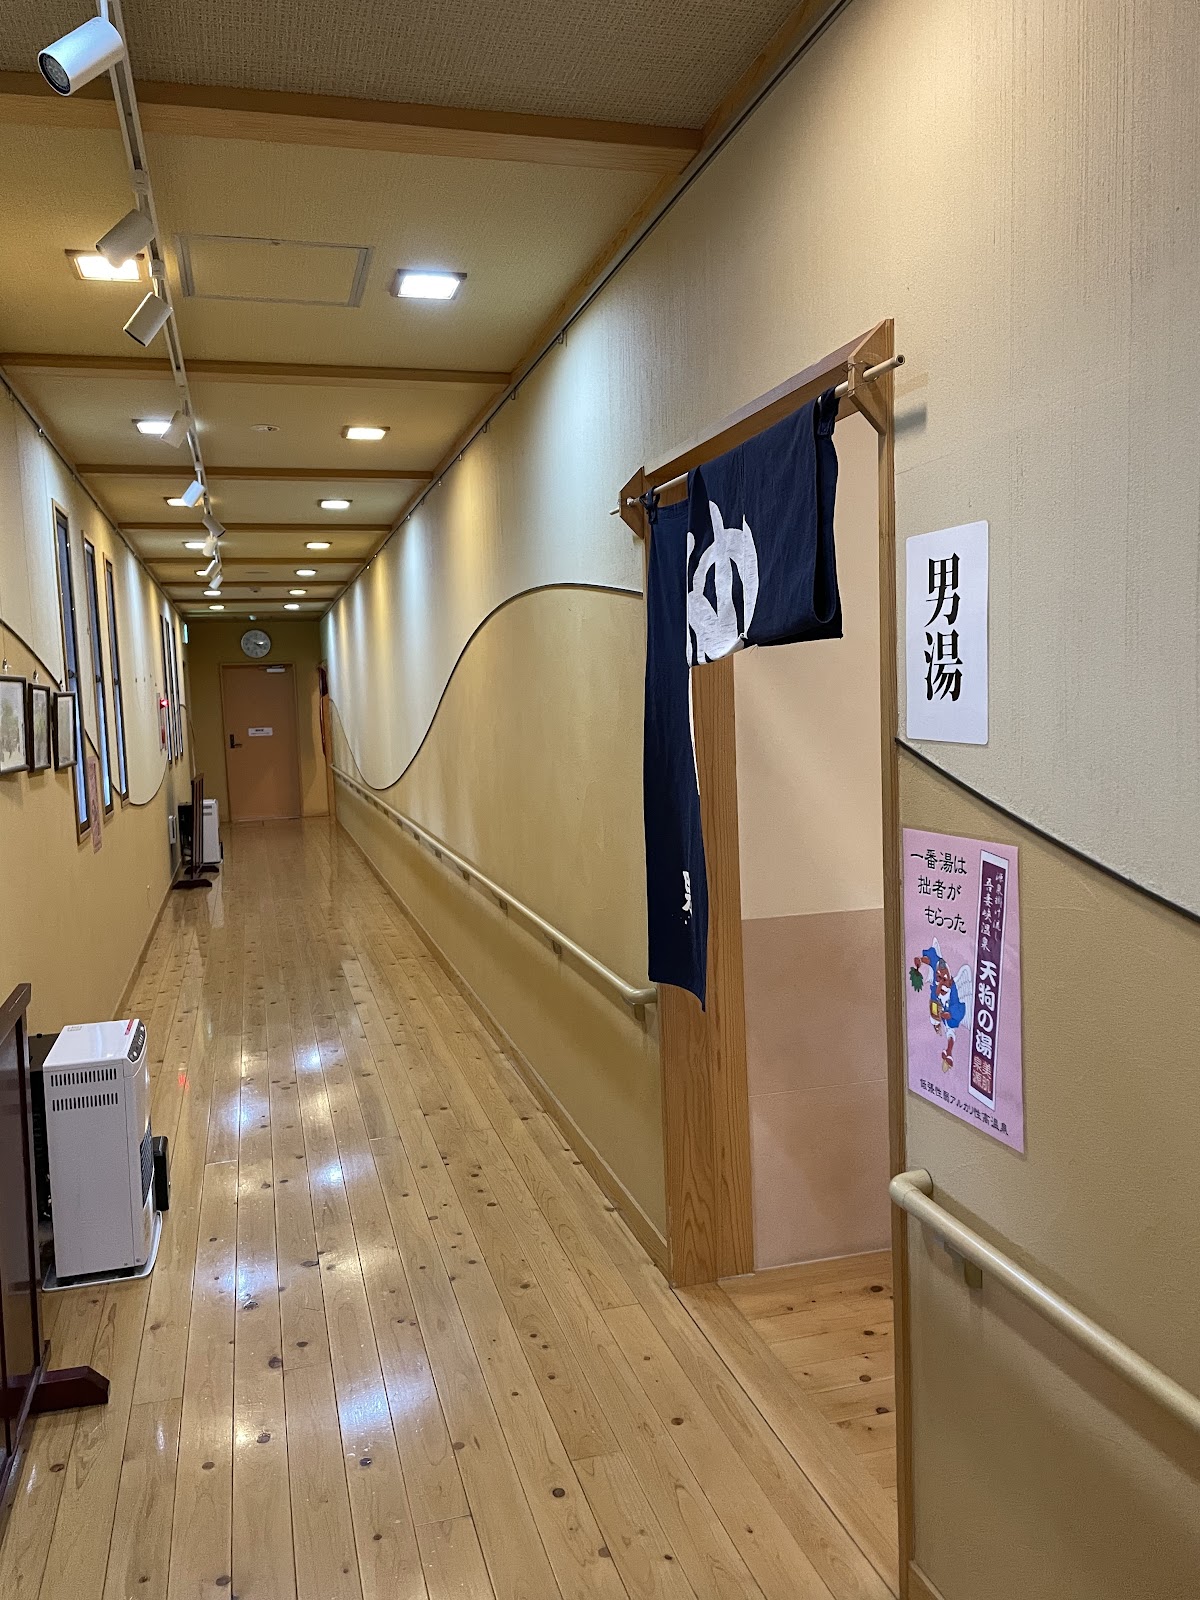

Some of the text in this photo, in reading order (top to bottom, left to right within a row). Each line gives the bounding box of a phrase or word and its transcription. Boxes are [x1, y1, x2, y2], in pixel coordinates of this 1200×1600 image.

[924, 552, 963, 702] 男湯
[910, 849, 968, 875] 一番湯は
[918, 875, 962, 901] 拙者が
[924, 905, 967, 934] もらった
[981, 877, 994, 952] 吾妻峡温泉
[975, 960, 997, 1060] 天狗の湯
